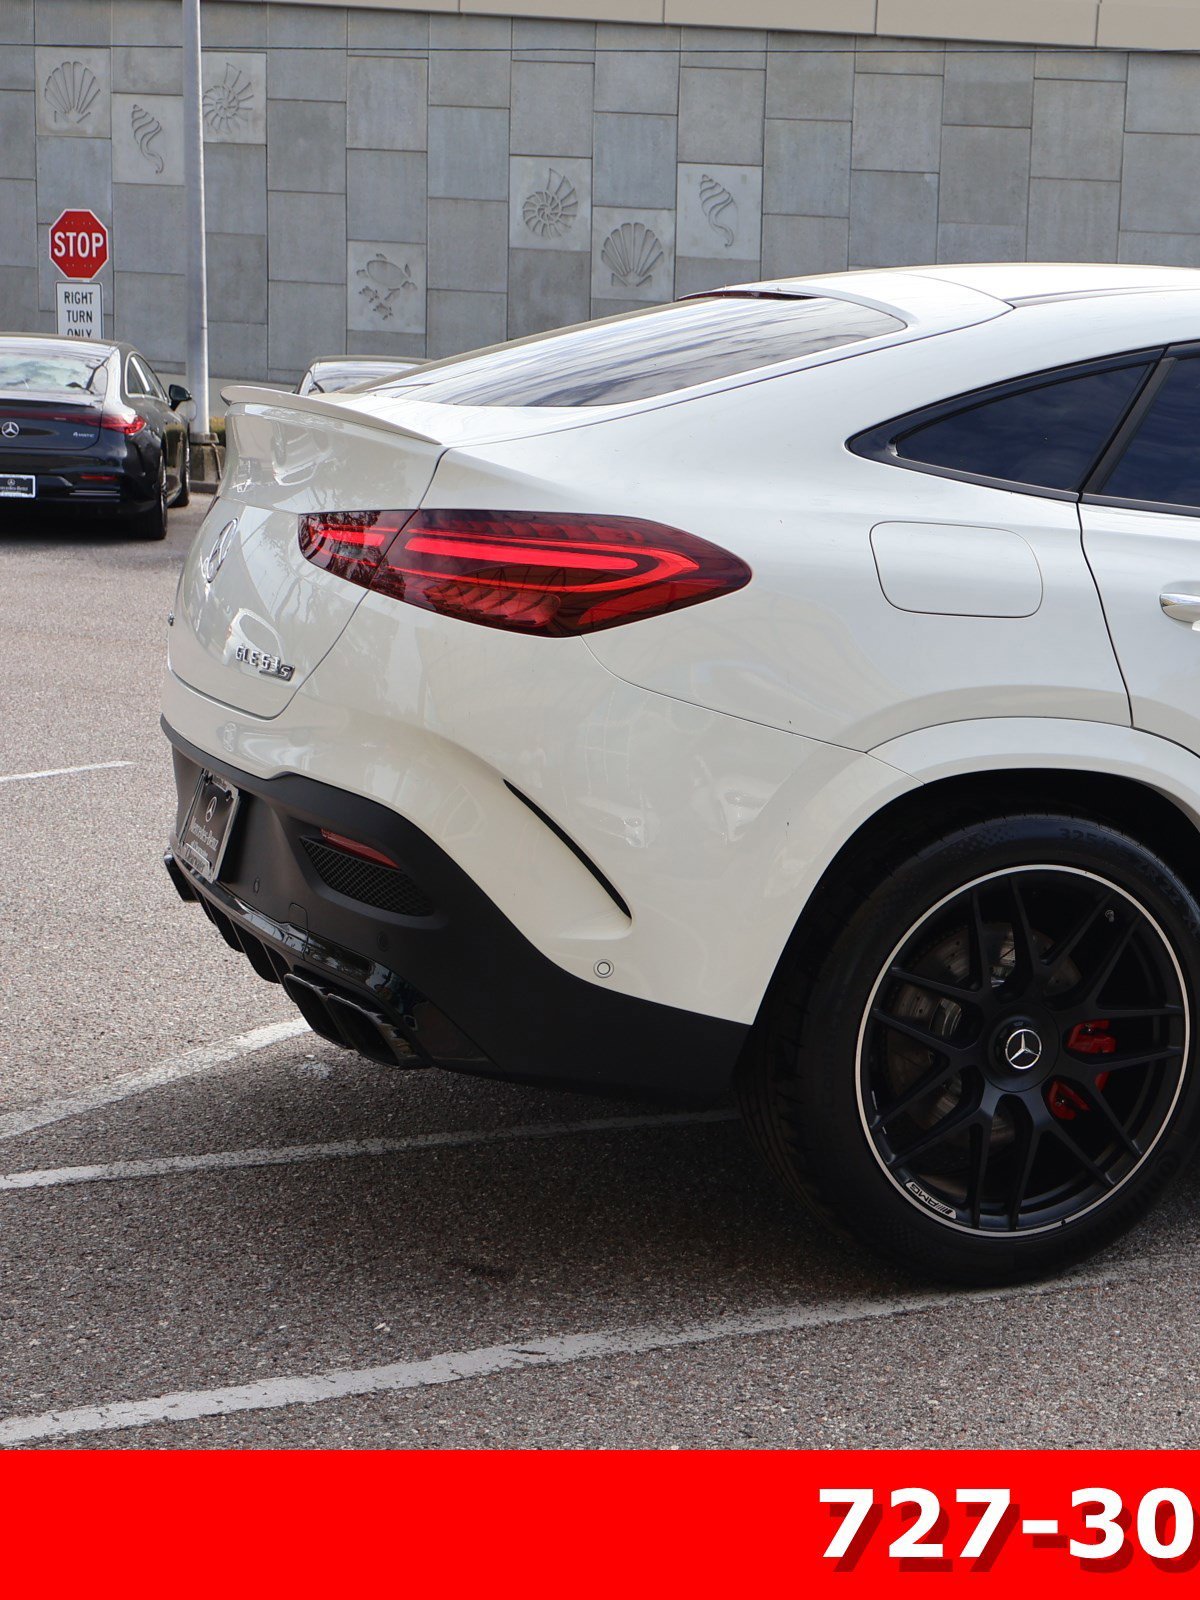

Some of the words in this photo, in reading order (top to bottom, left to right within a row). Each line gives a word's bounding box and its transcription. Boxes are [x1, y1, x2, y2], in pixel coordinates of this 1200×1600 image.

[54, 231, 104, 258] STOP
[64, 292, 93, 305] RIGHT
[66, 310, 93, 323] TURN
